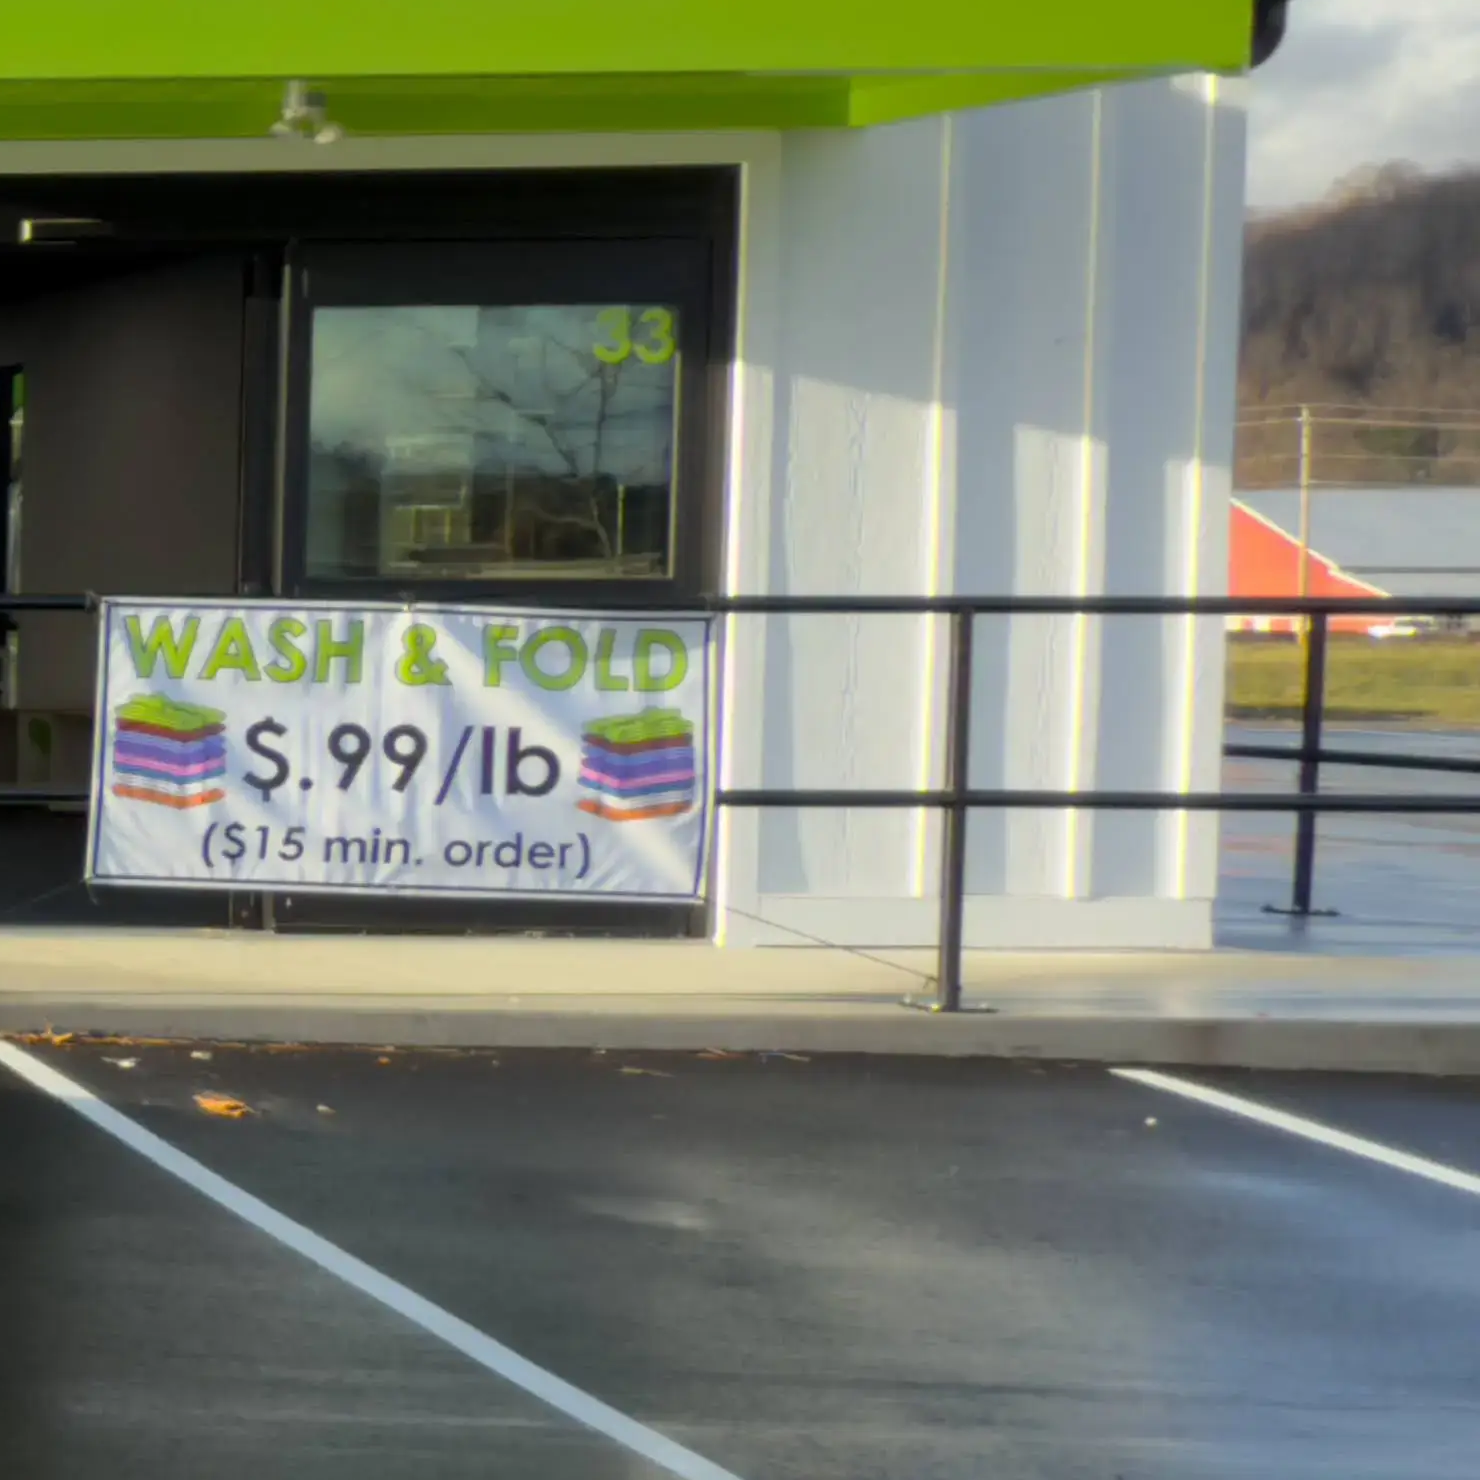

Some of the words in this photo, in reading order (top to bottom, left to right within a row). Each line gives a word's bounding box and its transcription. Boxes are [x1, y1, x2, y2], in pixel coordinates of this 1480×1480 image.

[593, 305, 676, 365] 33
[124, 615, 363, 686] WASH
[394, 622, 453, 686] &
[482, 624, 690, 692] FOLD
[241, 716, 561, 806] $.99/lb
[200, 822, 306, 869] ($15
[322, 828, 424, 866] min.
[443, 832, 591, 879] order)
